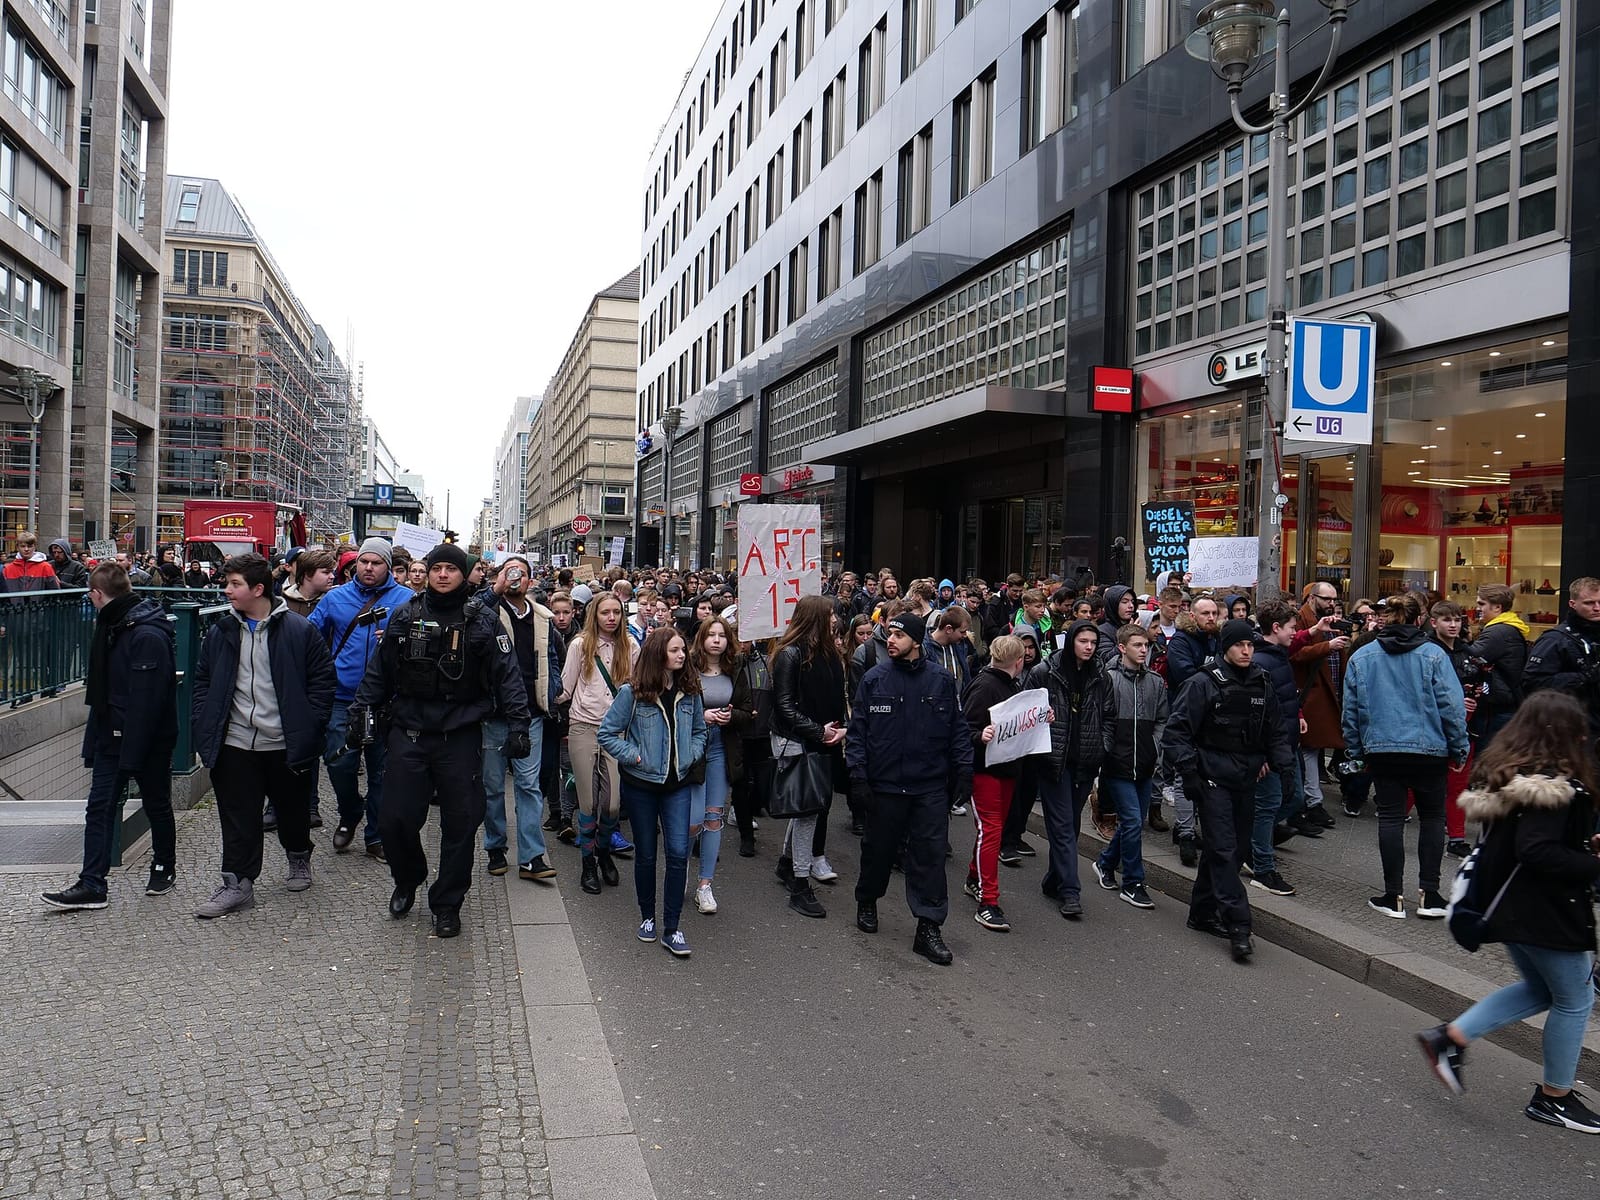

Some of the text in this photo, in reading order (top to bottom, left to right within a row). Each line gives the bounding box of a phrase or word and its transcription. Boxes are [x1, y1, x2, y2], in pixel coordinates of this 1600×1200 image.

[1235, 352, 1257, 371] LE
[1303, 324, 1361, 406] U
[1319, 418, 1340, 434] U6
[378, 486, 390, 499] U
[651, 503, 664, 512] dm
[220, 517, 244, 527] LEX
[573, 520, 591, 530] STOP
[741, 527, 816, 577] ART.
[1148, 545, 1187, 557] UPLOA
[869, 705, 892, 713] POLIZEI
